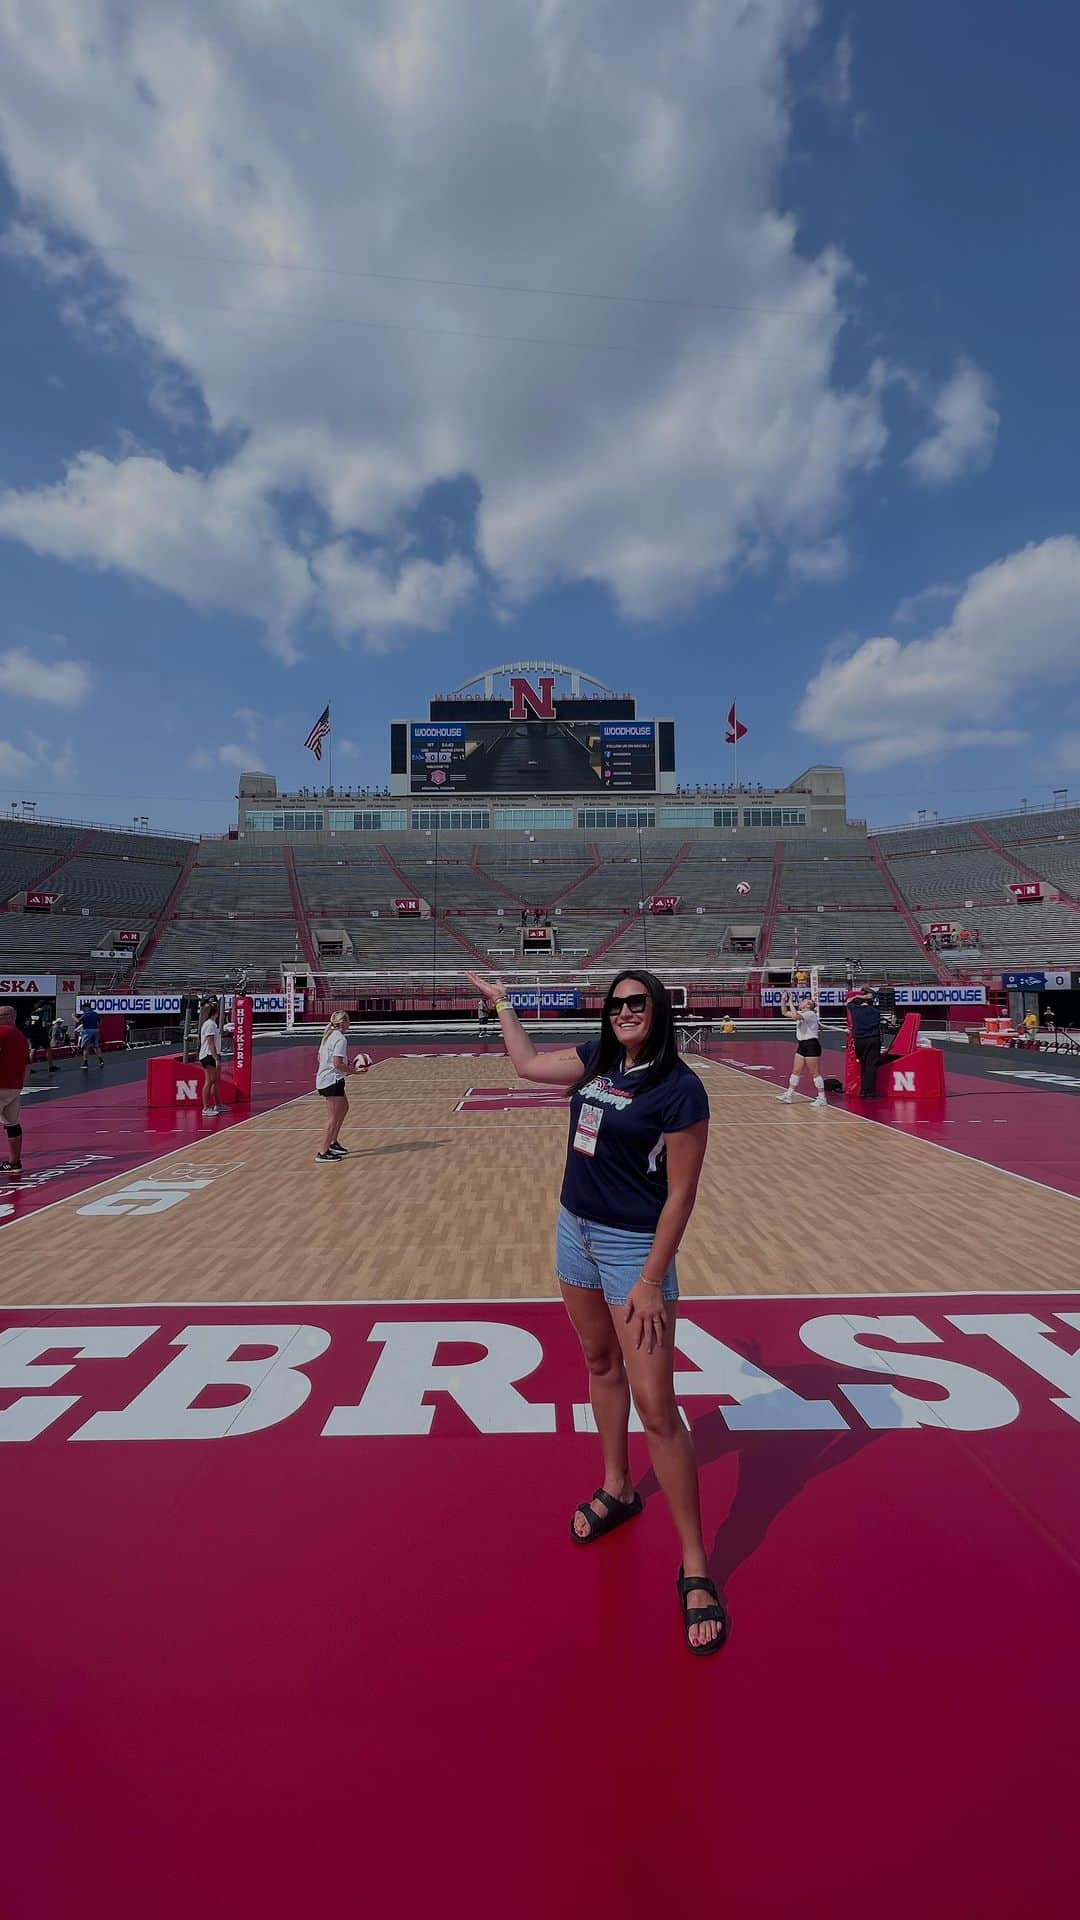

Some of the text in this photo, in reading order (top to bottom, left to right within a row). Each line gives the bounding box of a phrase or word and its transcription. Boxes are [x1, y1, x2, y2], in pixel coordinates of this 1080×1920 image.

[510, 677, 556, 719] N
[414, 727, 462, 737] WOODHOUSE
[604, 727, 651, 736] WOODHOUSE
[0, 980, 39, 992] SKA
[62, 980, 75, 991] N
[764, 990, 834, 1003] WODHOSE
[912, 989, 982, 1002] WOODHOUSE
[236, 1008, 244, 1068] HUSKERS
[892, 1071, 915, 1091] N
[176, 1080, 198, 1100] N
